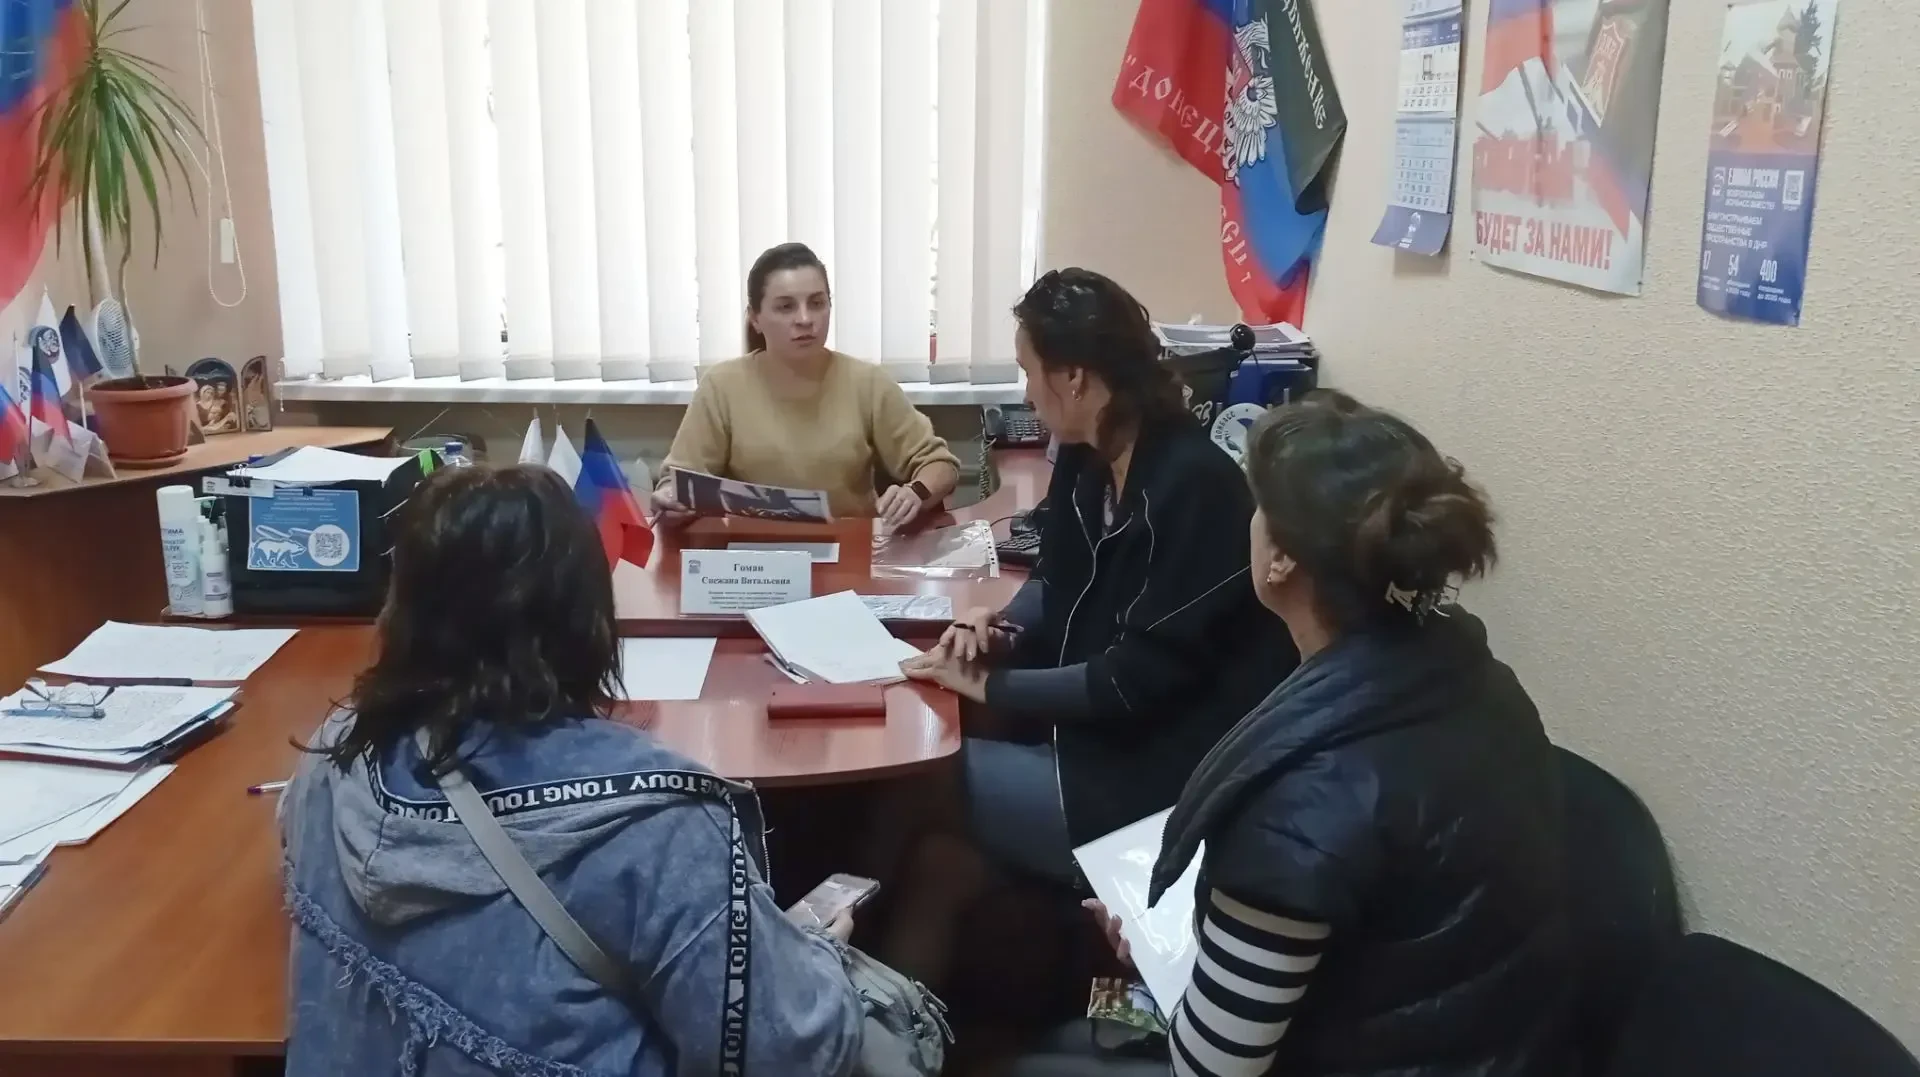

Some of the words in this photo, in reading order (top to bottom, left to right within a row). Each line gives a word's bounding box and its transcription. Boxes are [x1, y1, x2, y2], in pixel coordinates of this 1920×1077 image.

[1476, 210, 1522, 255] БУДЕТ
[1523, 217, 1545, 257] ЗА
[1549, 222, 1614, 270] НАМИ!
[1728, 254, 1739, 276] 54
[1759, 259, 1777, 283] 400
